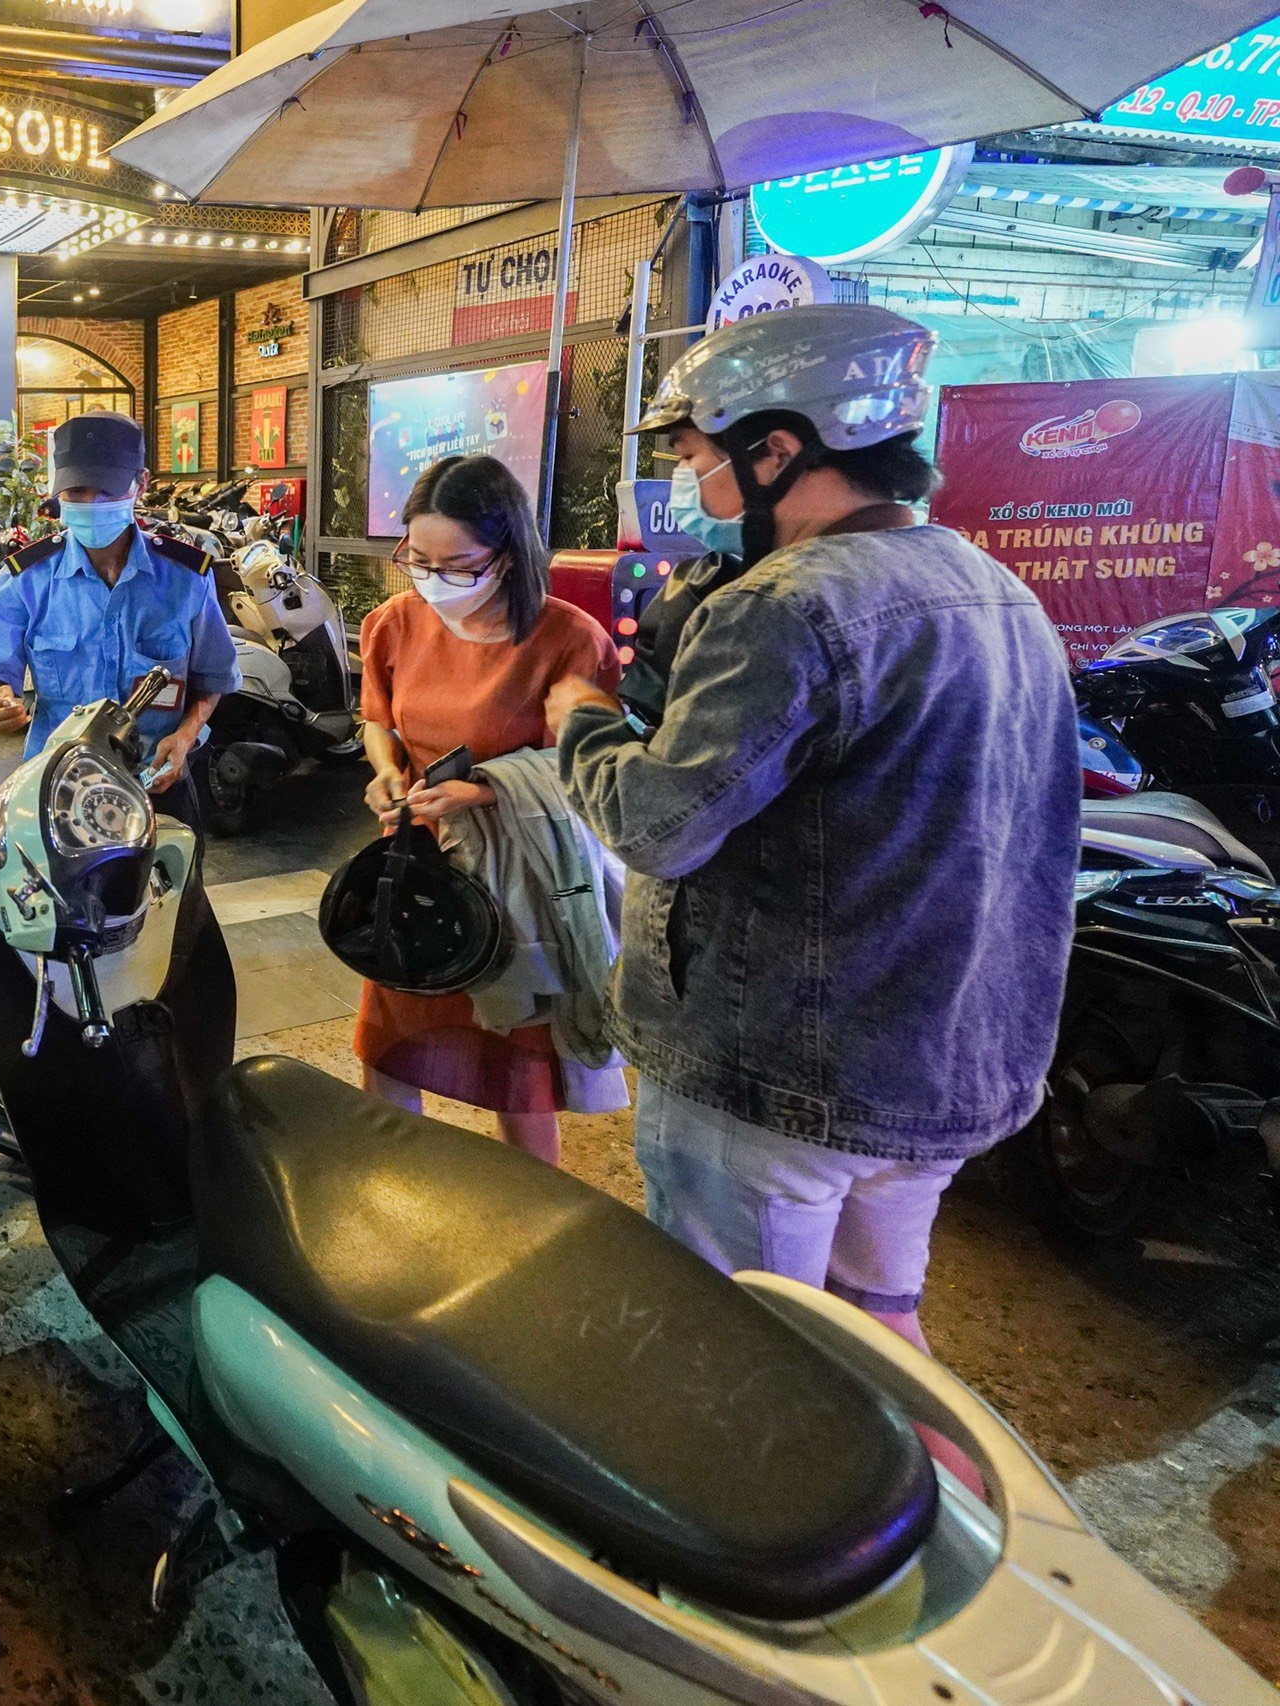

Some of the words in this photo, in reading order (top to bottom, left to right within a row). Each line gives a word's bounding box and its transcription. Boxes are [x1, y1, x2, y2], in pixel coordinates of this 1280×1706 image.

[720, 262, 803, 307] KARAOKE
[1025, 420, 1094, 446] KENO
[649, 500, 682, 534] CO
[989, 502, 1014, 521] XỔ
[1018, 500, 1043, 520] SỐ
[1045, 502, 1093, 519] KENO
[997, 522, 1094, 550] TRÚNG
[1099, 518, 1205, 546] KHỦNG
[1017, 556, 1090, 585] THẬT
[1094, 556, 1178, 579] SUNG
[1135, 895, 1214, 907] LEAD
